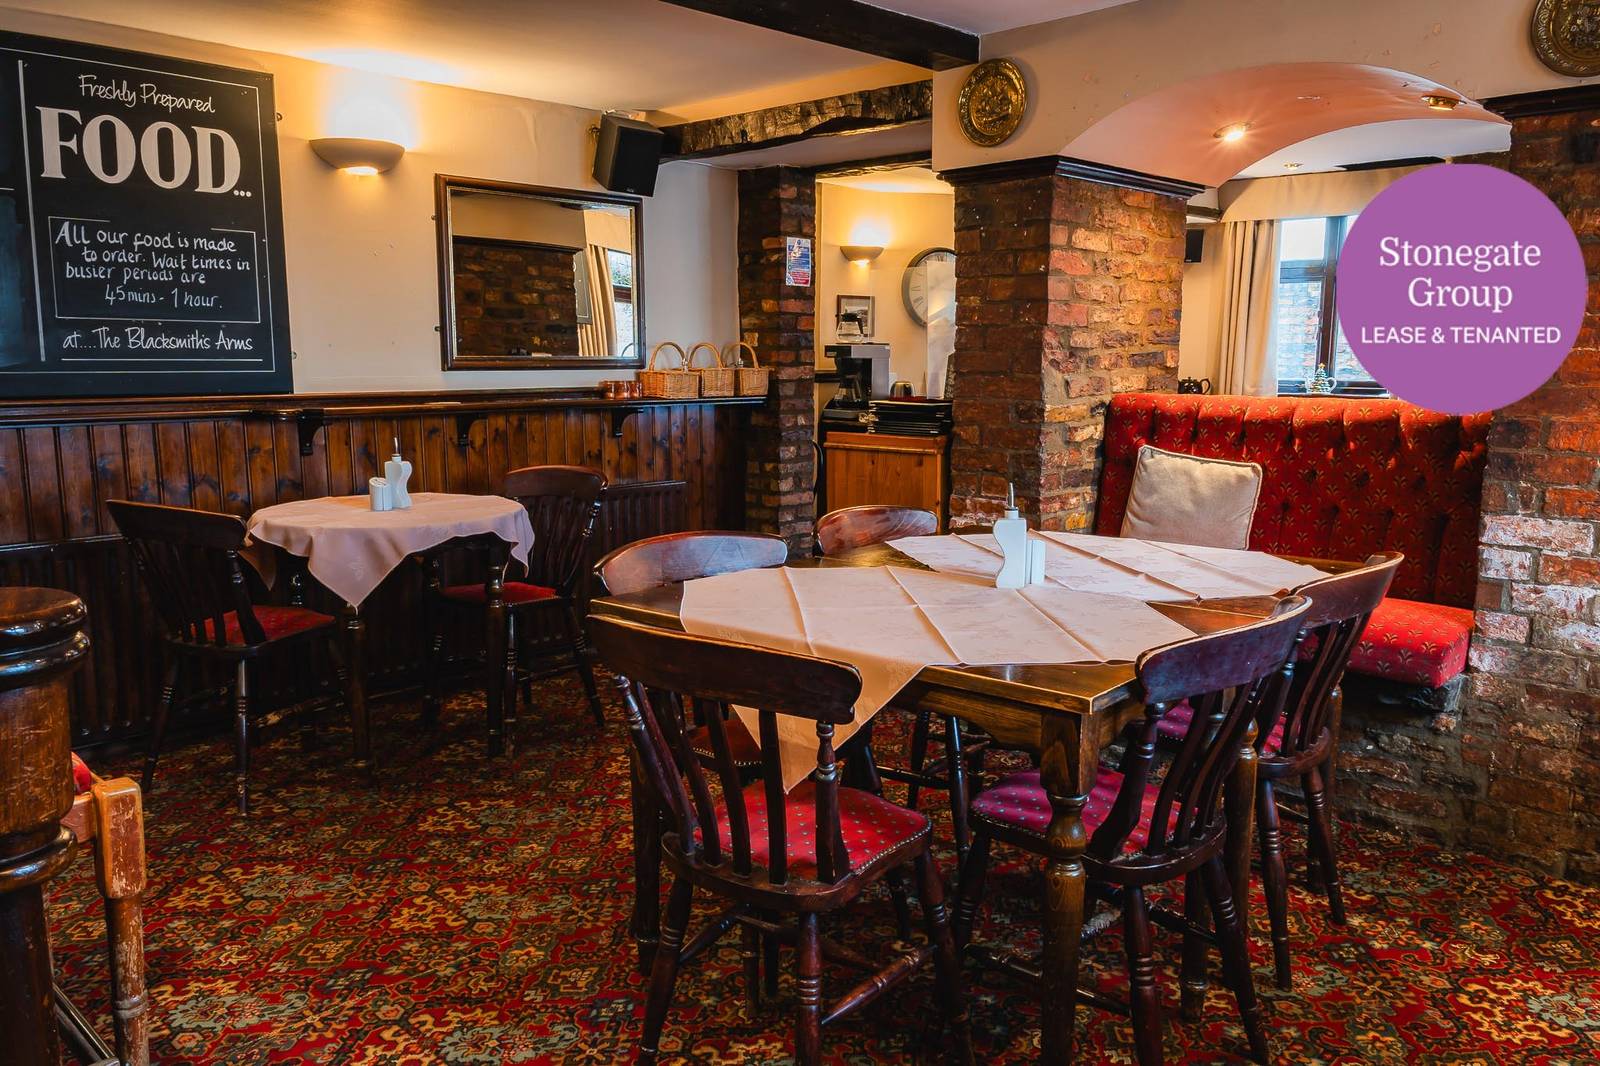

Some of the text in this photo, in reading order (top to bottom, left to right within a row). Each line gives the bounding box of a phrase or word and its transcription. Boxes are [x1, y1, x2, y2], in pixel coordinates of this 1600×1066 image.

[78, 74, 215, 113] Freshly Prepared
[55, 221, 238, 252] All our food is made
[82, 246, 251, 271] to order. Wait times in
[66, 261, 206, 285] busier periods are
[171, 287, 178, 309] 1
[184, 291, 223, 309] hour.
[215, 329, 254, 351] Arms
